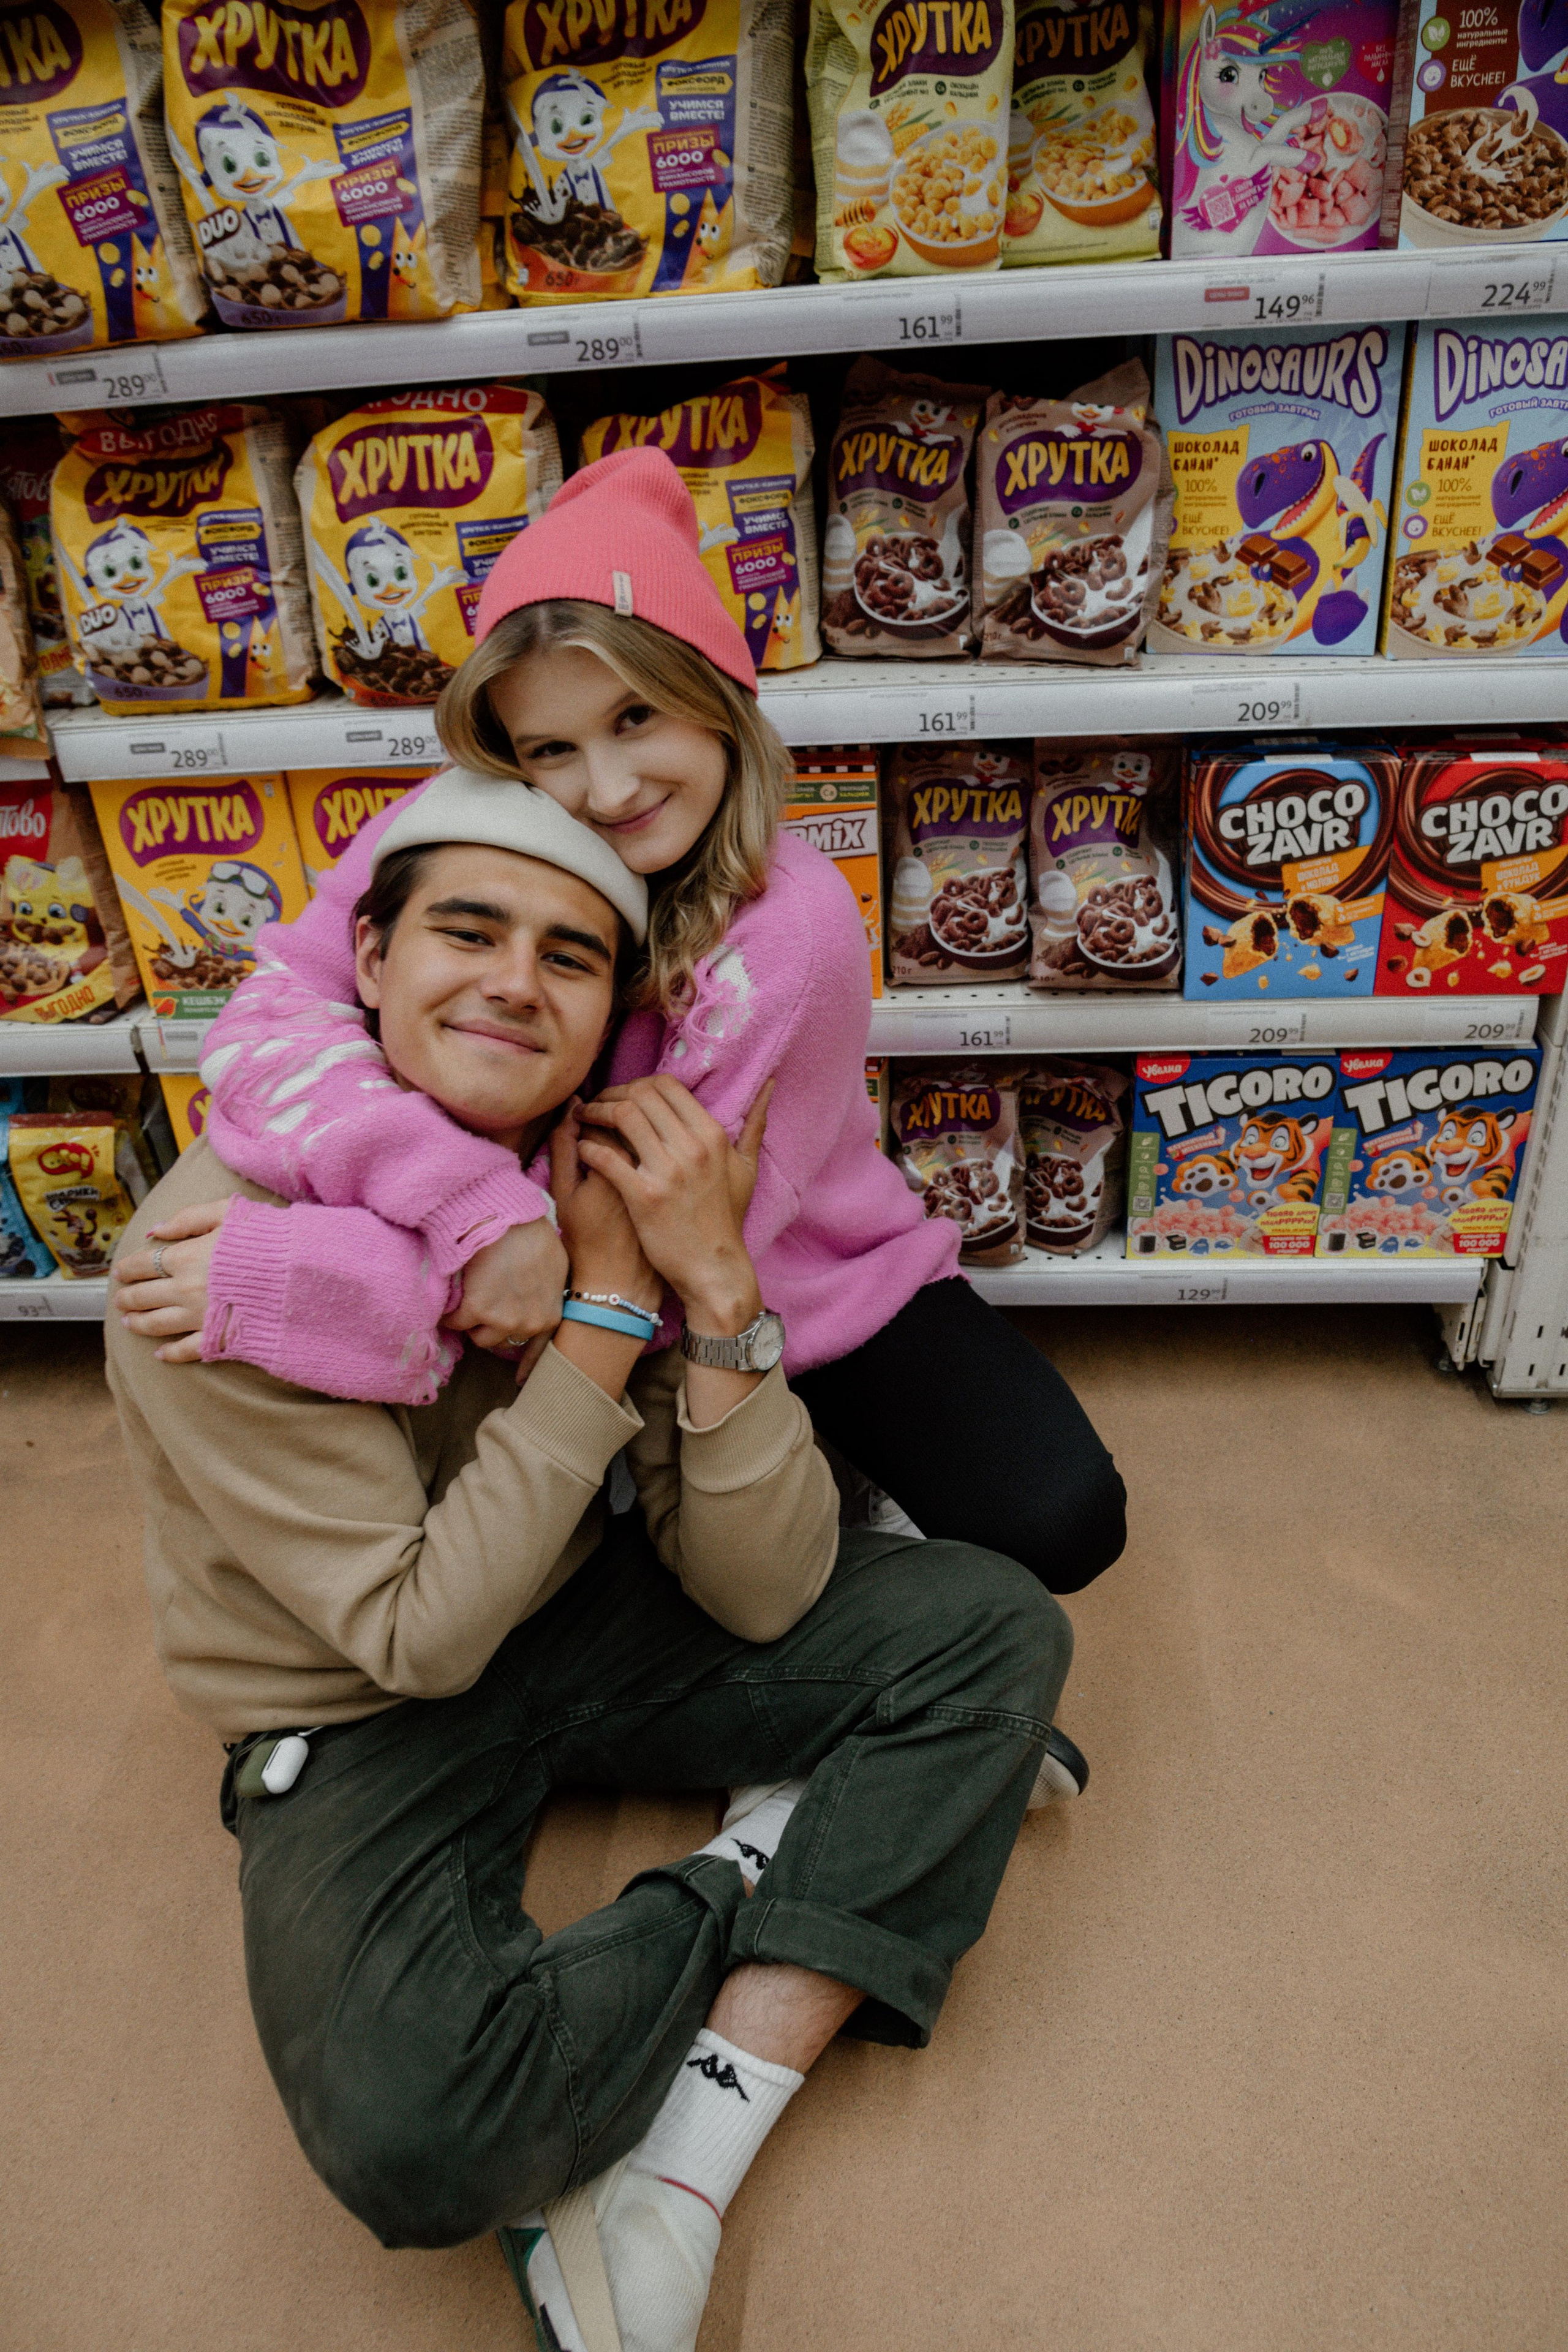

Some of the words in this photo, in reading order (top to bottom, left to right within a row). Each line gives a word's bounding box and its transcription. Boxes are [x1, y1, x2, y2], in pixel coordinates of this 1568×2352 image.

[1459, 7, 1498, 29] 100%
[535, 0, 693, 66] ХРУТКА
[876, 1, 992, 83] ХРУТКА
[1456, 37, 1507, 48] ингредиенты
[1457, 28, 1508, 40] натуральные
[190, 2, 359, 87] ХРУТКА
[1452, 54, 1477, 73] ЕЩЁ
[1450, 71, 1506, 88] ВКУСНЕЕ!
[668, 99, 724, 110] УЧИМСЯ
[669, 110, 725, 121] ВМЕСТЕ!
[653, 135, 715, 154] ПРИЗЫ
[72, 150, 129, 172] ВМЕСТЕ!
[655, 150, 704, 169] 6000
[336, 165, 397, 191] ПРИЗЫ
[66, 178, 127, 208] ПРИЗЫ
[339, 181, 389, 203] 6000
[73, 197, 120, 222] 6000
[198, 208, 239, 245] DUO
[1482, 282, 1530, 307] 224
[241, 311, 271, 324] 650
[1254, 295, 1300, 320] 149
[899, 316, 940, 340] 161
[576, 338, 619, 362] 289
[104, 375, 146, 399] 289
[1229, 402, 1276, 422] ГОТОВЫЙ
[1278, 403, 1321, 420] ЗАВТРАК
[1489, 396, 1538, 419] ГОТОВЫЙ
[1174, 440, 1240, 454] ШОКОЛАД
[1428, 437, 1498, 453] ШОКОЛАД
[337, 431, 481, 505] ХРУТКА
[838, 431, 951, 487] ХРУТКА
[1004, 440, 1131, 497] ХРУТКА
[1186, 478, 1217, 492] 100%
[1438, 478, 1472, 493] 100%
[743, 512, 786, 525] УЧИМС
[1433, 512, 1456, 526] ЕЩЁ
[1182, 525, 1229, 536] ВКУСНЕЕ!
[1431, 526, 1482, 538] ВКУСНЕЕ!
[732, 541, 784, 564] ПРИЗЫ
[735, 556, 777, 575] 6000
[200, 571, 254, 593] ПРИЗЫ
[205, 586, 247, 605] 6000
[81, 605, 116, 635] DUO
[919, 712, 956, 732] 161
[1238, 701, 1280, 722] 209
[388, 737, 425, 756] 289
[170, 749, 208, 768] 289
[321, 786, 414, 845] ХРУ
[912, 786, 1023, 830] ХРУТКА
[1218, 782, 1367, 841] CHOCO
[1420, 782, 1568, 839] CHOCO
[126, 794, 256, 854] ХРУТКА
[1246, 818, 1354, 866] ZAVR
[1445, 817, 1555, 865] ZAVR
[960, 1031, 993, 1047] 161
[1248, 1028, 1288, 1043] 209
[1464, 1023, 1505, 1039] 209
[1142, 1063, 1183, 1079] Увелка
[1343, 1057, 1385, 1072] Увелка
[1143, 1065, 1334, 1140] TIGORO
[1343, 1058, 1535, 1135] TIGORO
[1269, 1241, 1287, 1250] 100
[1288, 1240, 1311, 1249] 000
[1459, 1240, 1477, 1248] 100
[1478, 1238, 1501, 1248] 000
[1177, 1289, 1211, 1301] 129
